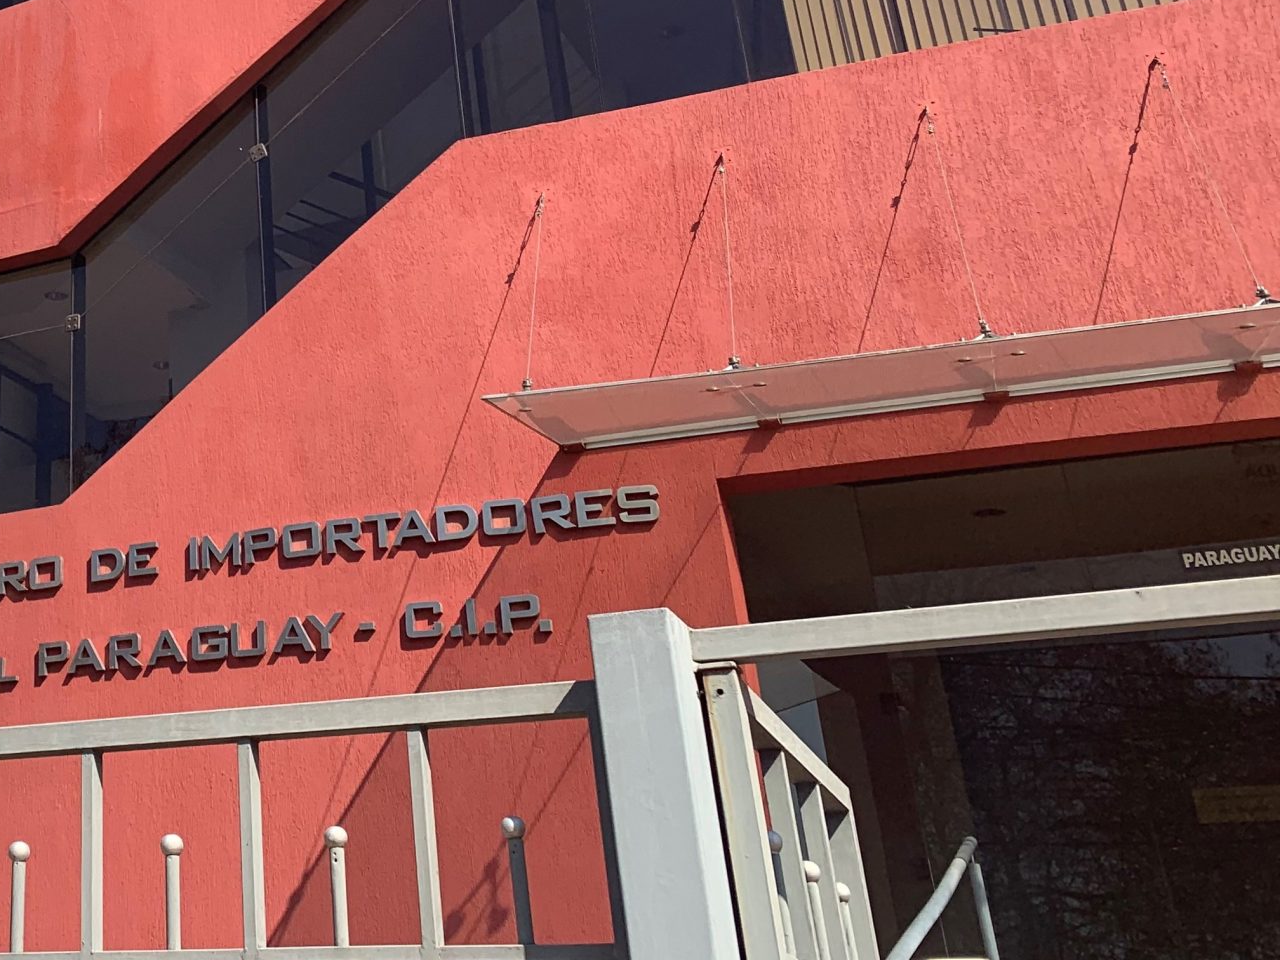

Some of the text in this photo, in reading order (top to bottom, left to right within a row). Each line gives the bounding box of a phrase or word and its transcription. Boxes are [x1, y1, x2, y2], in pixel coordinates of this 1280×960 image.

[89, 541, 158, 583] DE
[188, 483, 660, 572] IMPORTADORES
[1182, 544, 1280, 568] PARAGUAY
[37, 612, 344, 678] PARAGUAY
[404, 593, 553, 640] C.I.P.
